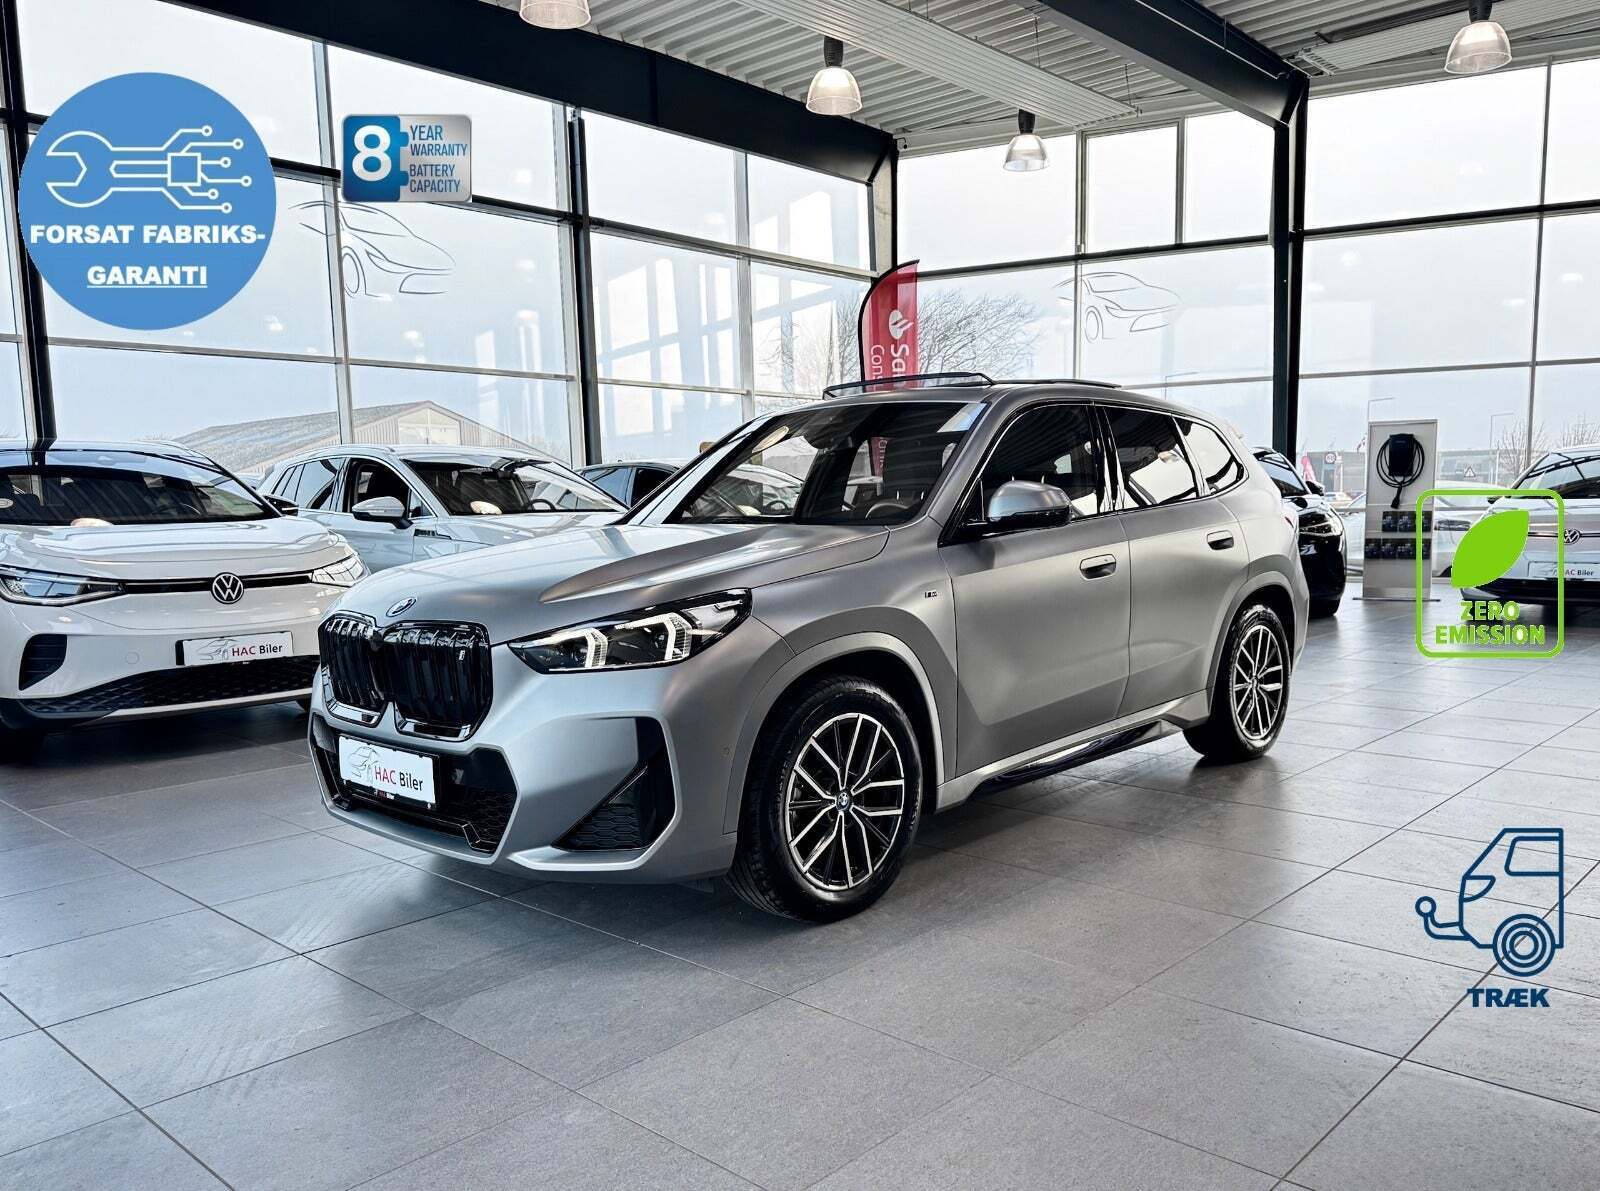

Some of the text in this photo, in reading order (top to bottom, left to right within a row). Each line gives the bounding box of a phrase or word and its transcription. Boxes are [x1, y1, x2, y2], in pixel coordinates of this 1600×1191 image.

[231, 644, 283, 657] HAC Biler
[374, 764, 423, 791] HAC Biler
